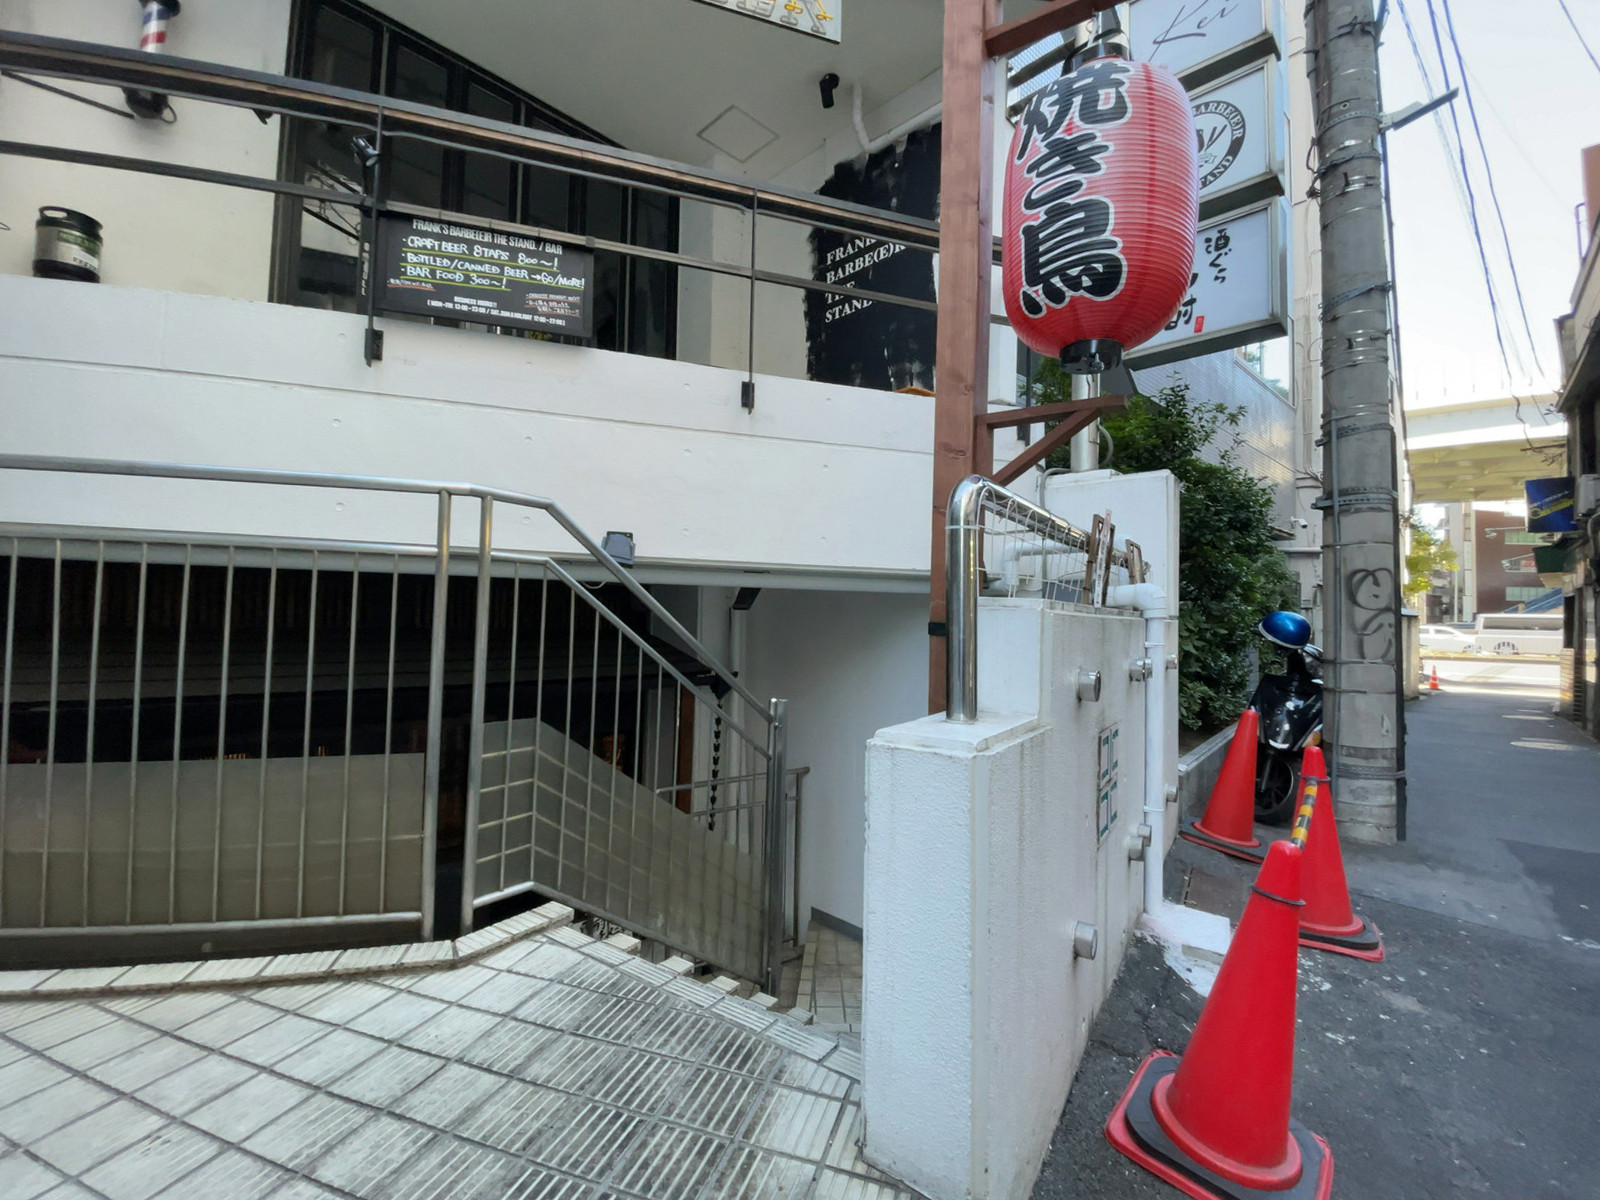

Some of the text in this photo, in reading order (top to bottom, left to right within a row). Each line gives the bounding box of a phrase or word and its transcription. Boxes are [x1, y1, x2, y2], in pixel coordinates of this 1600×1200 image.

[1016, 61, 1133, 317] 焼き鳥
[407, 235, 440, 251] CRAFT
[441, 240, 469, 254] BEER
[413, 218, 449, 235] FRANK'S
[493, 233, 508, 246] THE
[545, 243, 562, 255] BAR
[406, 265, 432, 279] BAR
[436, 269, 465, 282] FOOD
[504, 266, 529, 279] BEER
